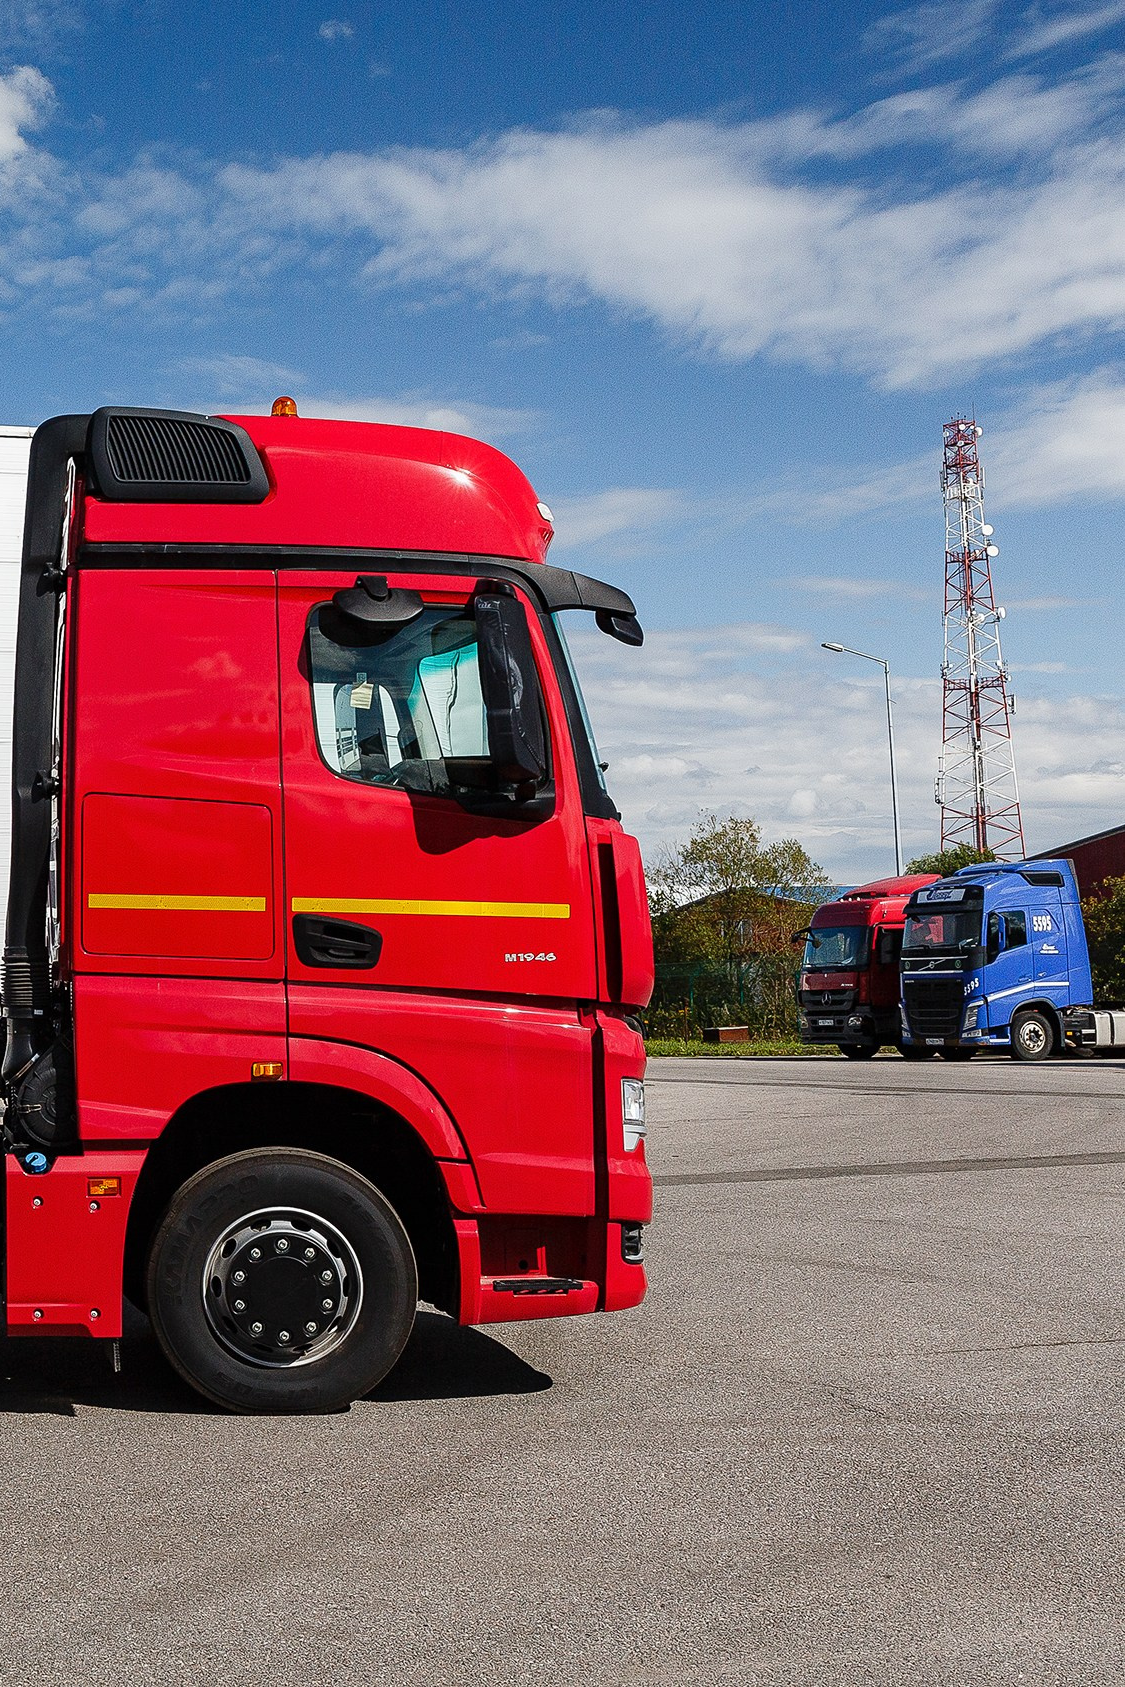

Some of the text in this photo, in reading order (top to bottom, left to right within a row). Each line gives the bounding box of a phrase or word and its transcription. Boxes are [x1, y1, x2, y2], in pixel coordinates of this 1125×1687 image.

[1033, 915, 1051, 931] 5595
[505, 952, 556, 962] M1946
[964, 978, 979, 995] 5595
